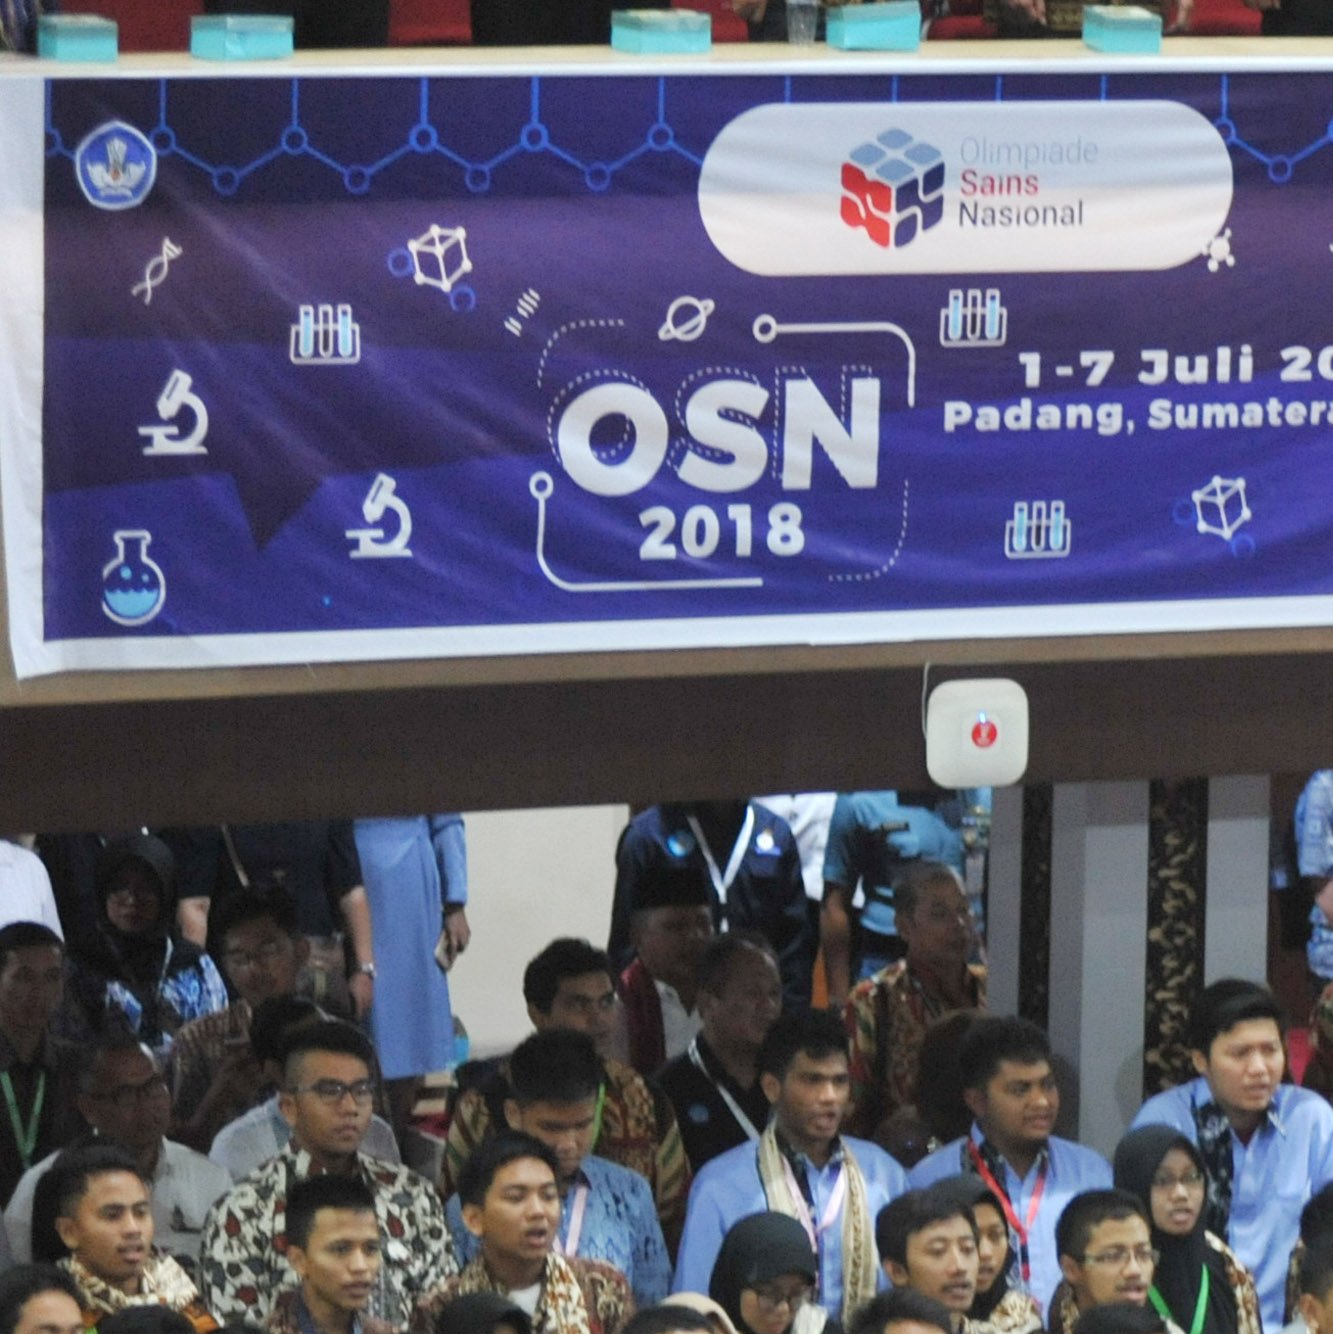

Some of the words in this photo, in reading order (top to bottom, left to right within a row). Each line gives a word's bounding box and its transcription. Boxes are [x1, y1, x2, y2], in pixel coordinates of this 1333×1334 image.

[960, 135, 1098, 168] Olimpiade
[960, 169, 1039, 196] Sains
[958, 199, 1083, 227] Nasional
[1018, 350, 1114, 387] 1-7
[1138, 344, 1254, 385] Juli
[944, 397, 1134, 436] Padang,
[558, 379, 881, 497] OSN
[639, 502, 804, 560] 2018
